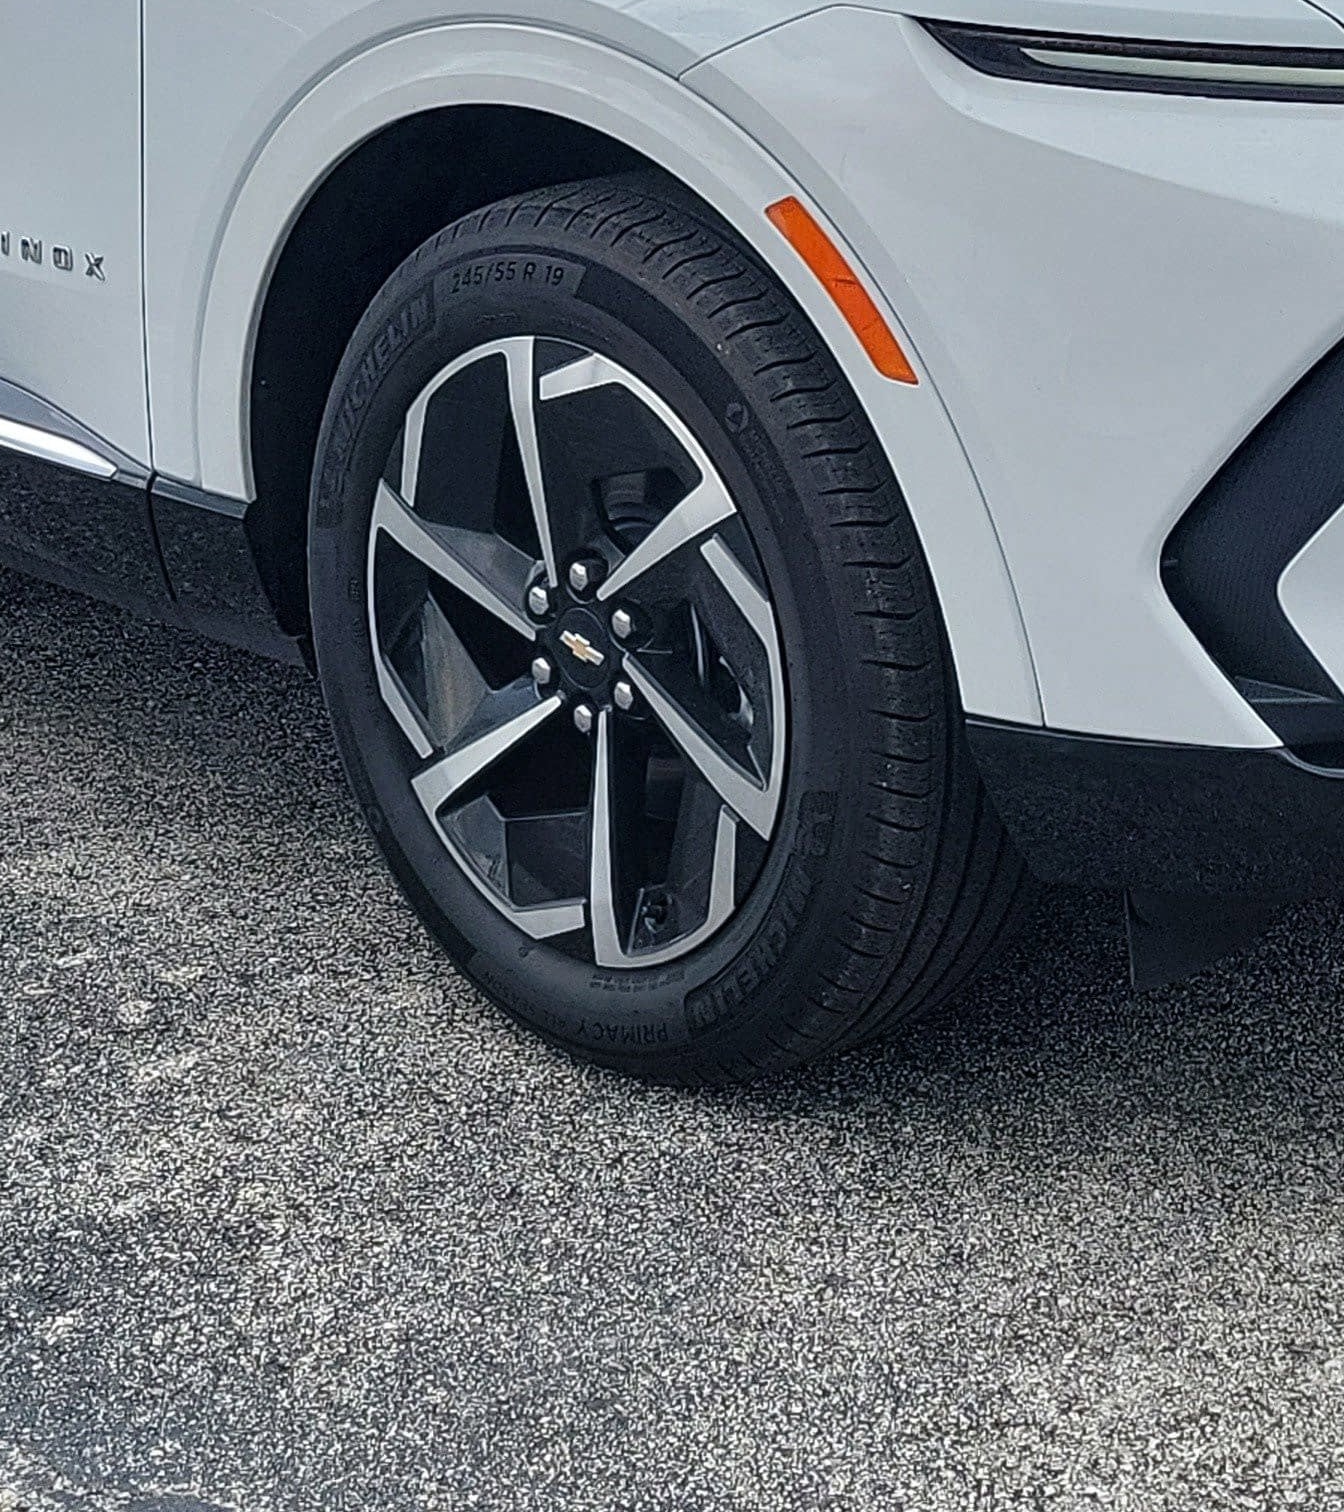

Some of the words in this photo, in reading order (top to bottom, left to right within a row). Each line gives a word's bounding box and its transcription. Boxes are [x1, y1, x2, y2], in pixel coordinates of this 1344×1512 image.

[452, 261, 516, 293] 245/55
[522, 261, 537, 281] R
[545, 264, 564, 286] 19
[572, 1018, 670, 1045] PRIMACY
